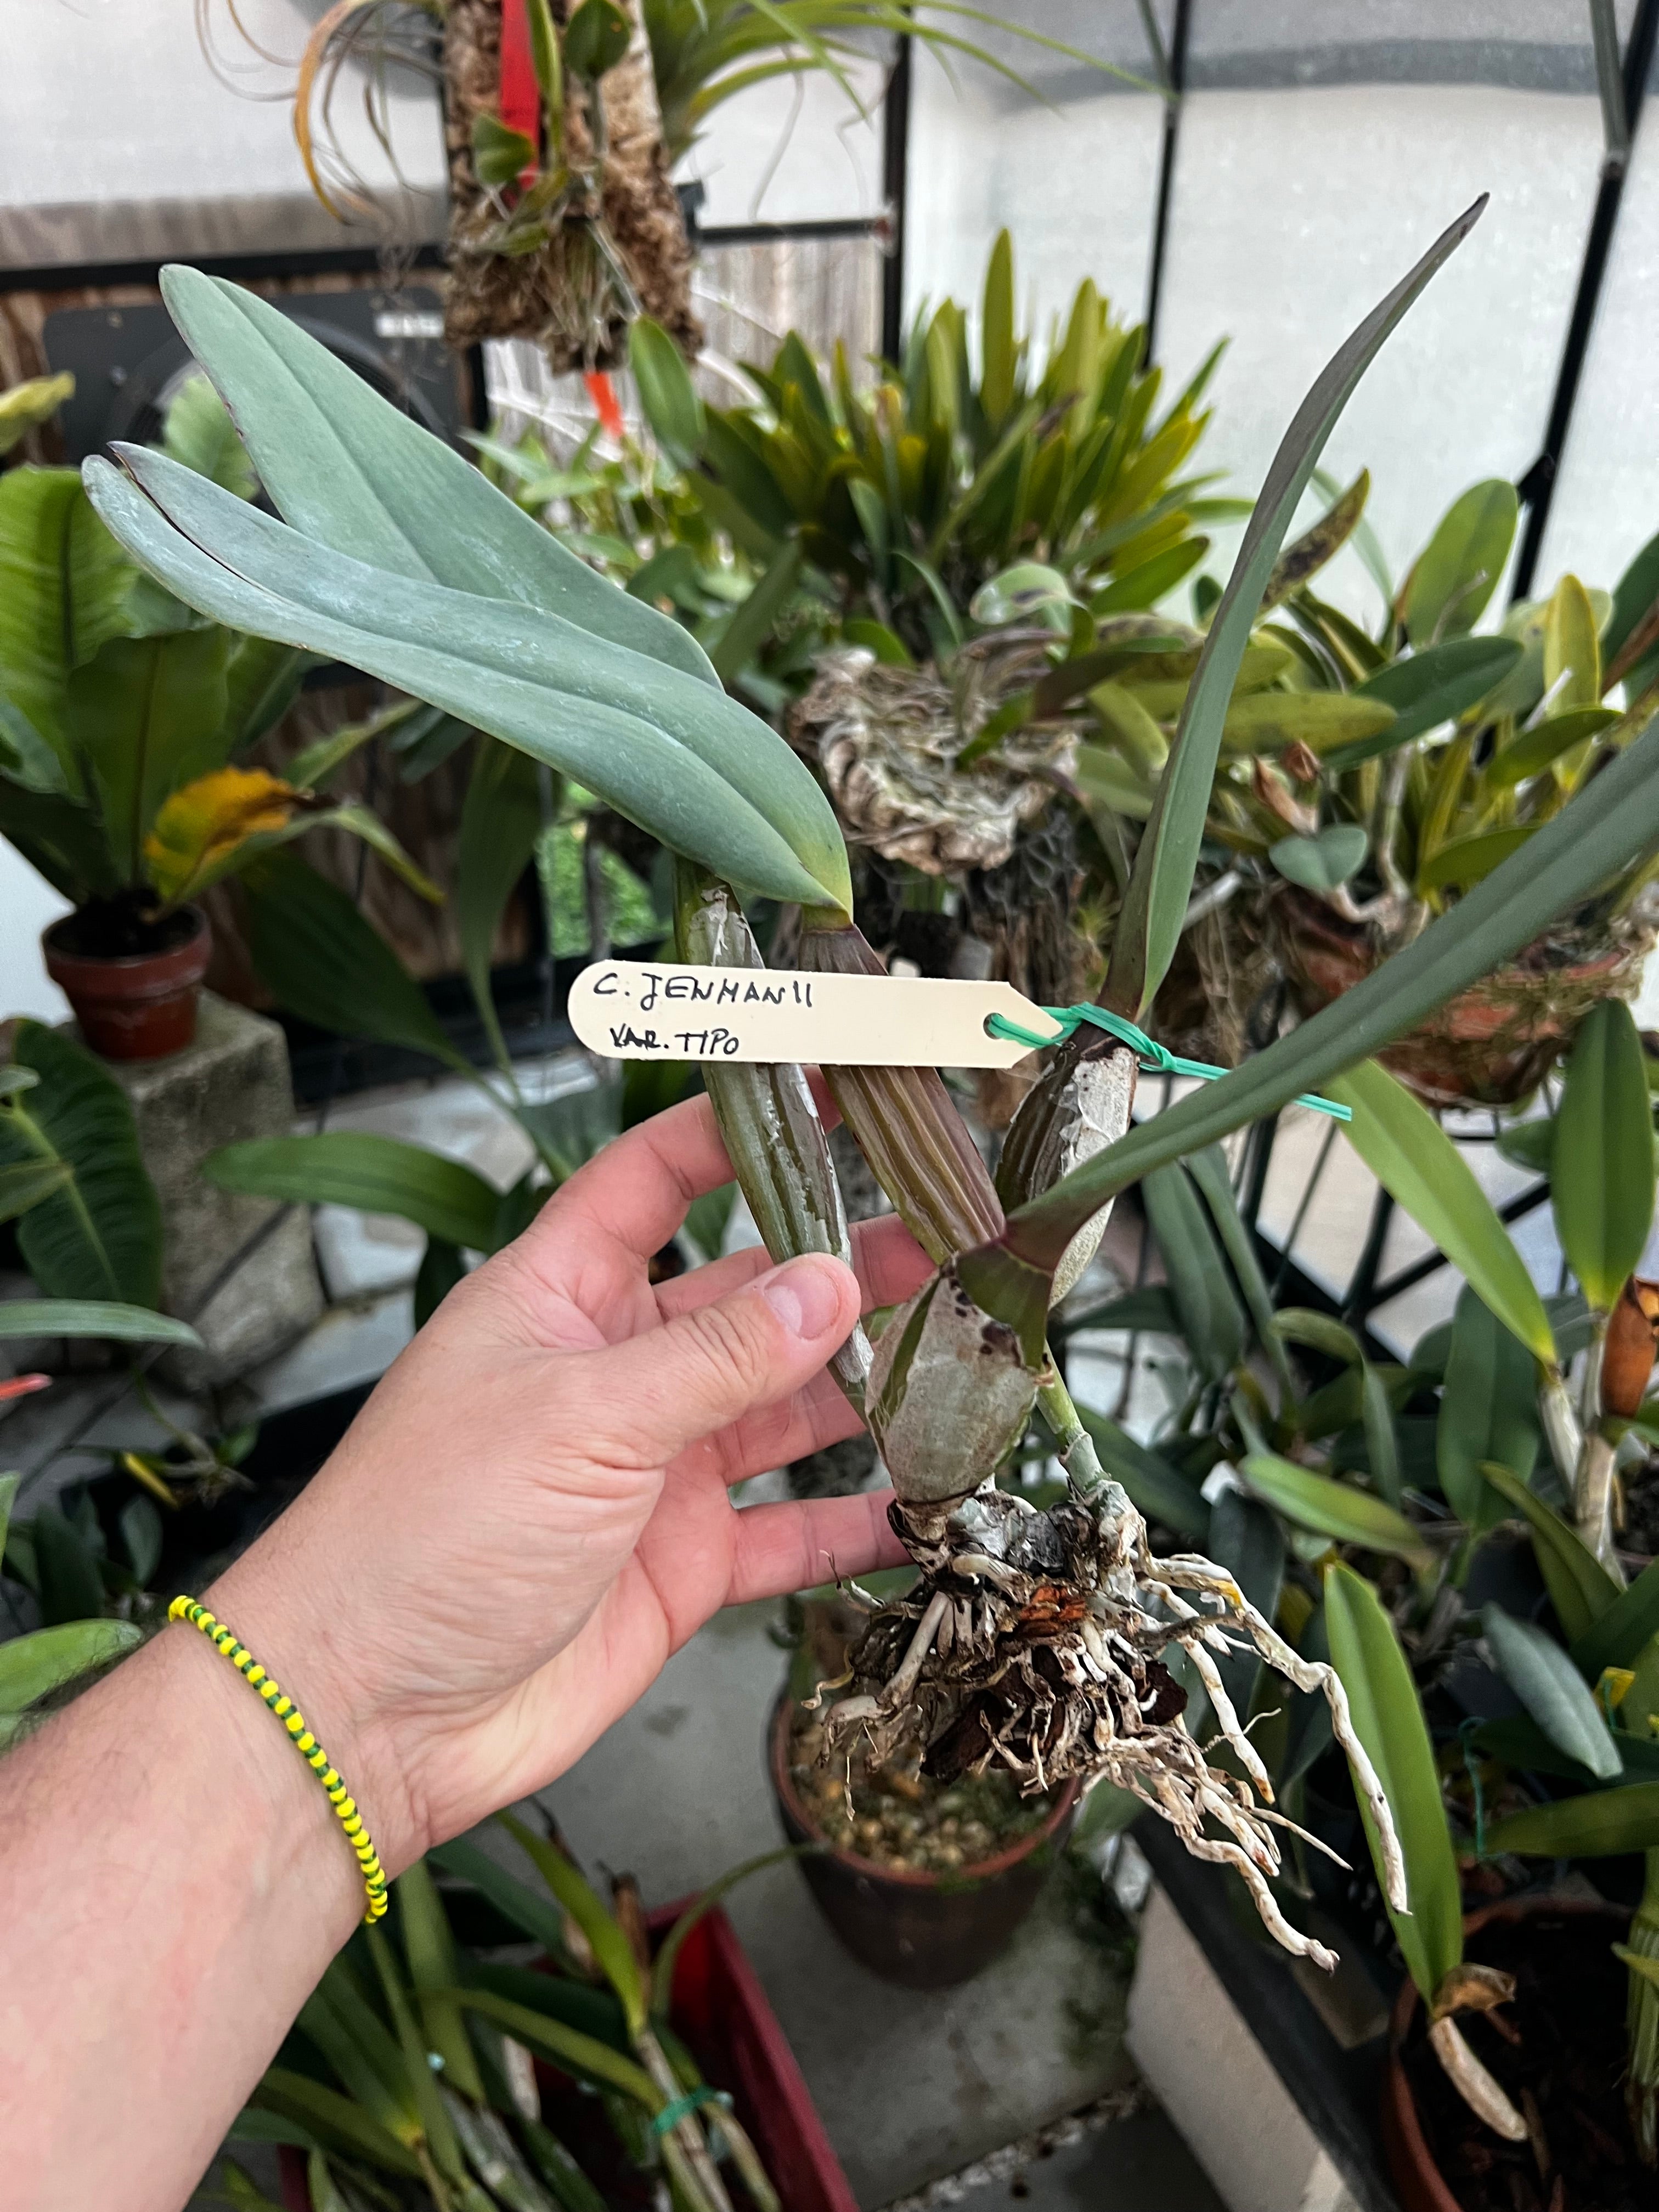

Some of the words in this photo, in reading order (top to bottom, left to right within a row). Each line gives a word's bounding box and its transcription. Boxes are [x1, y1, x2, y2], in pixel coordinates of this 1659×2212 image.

[593, 972, 630, 997] C.
[640, 972, 813, 1011] JENMANII
[610, 1023, 670, 1050] VAR.
[674, 1028, 740, 1055] TIPO
